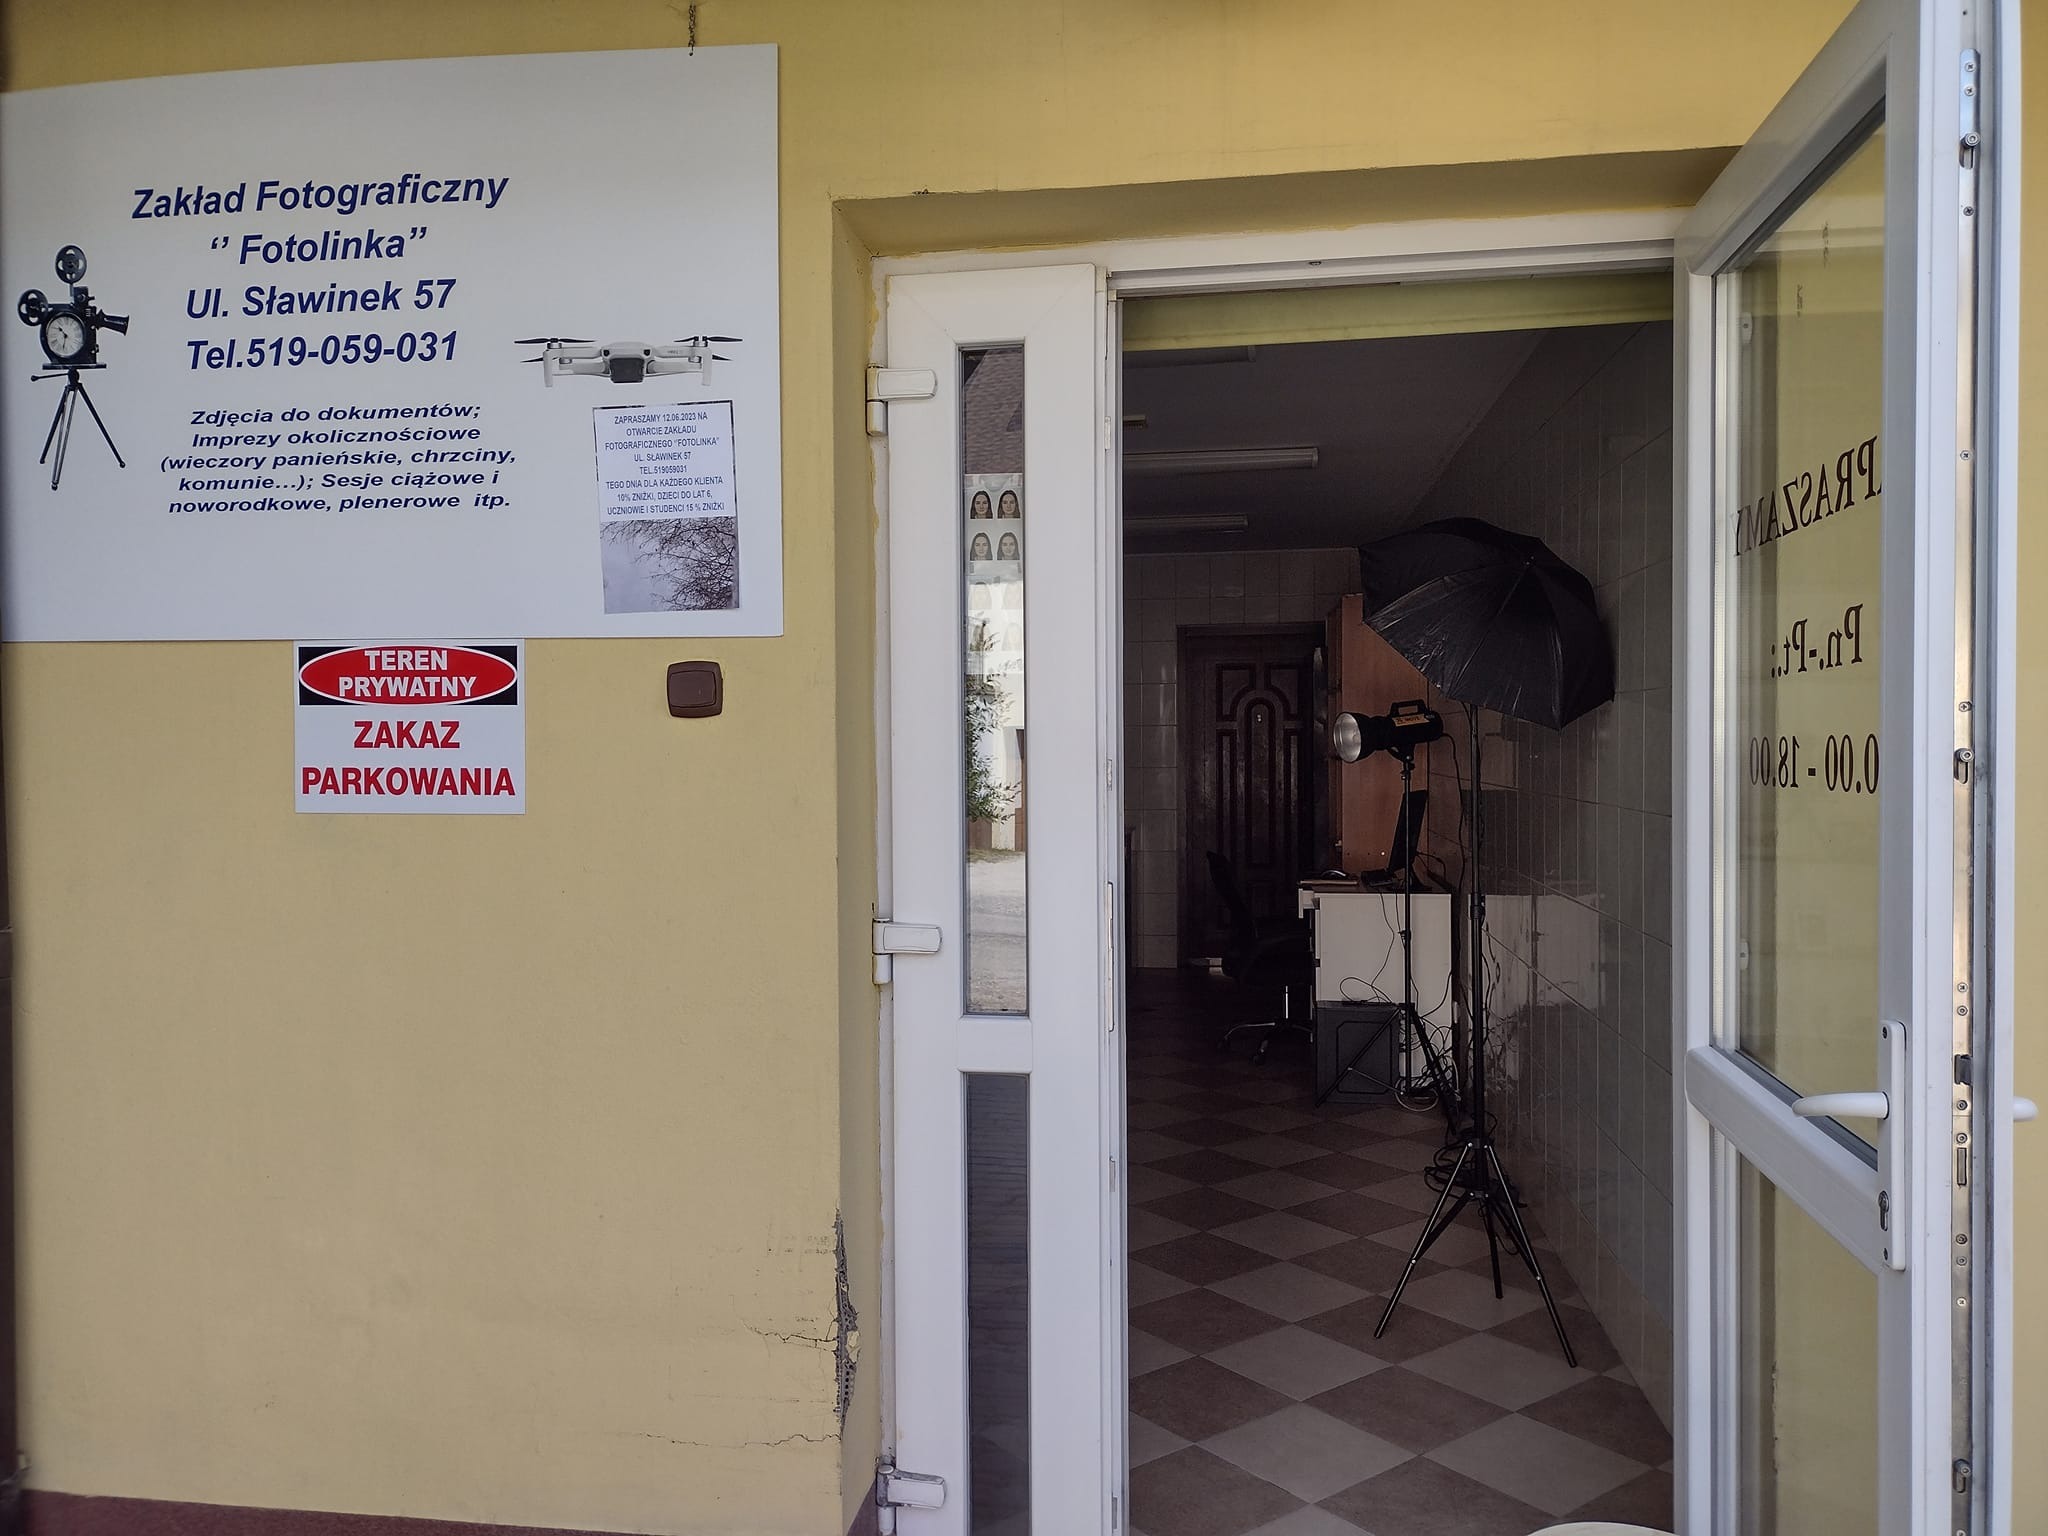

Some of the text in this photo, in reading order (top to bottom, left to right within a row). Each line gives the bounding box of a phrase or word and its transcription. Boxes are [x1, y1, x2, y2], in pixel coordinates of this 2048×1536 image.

[132, 173, 509, 219] Zakład Fotograficzny
[186, 279, 456, 318] Ul. Sławinek 57
[187, 330, 457, 369] Tel.519-059-031
[191, 403, 481, 427] Zdjęcia do dokumentów;
[614, 412, 708, 424] ZAPRASZAMY 12.06.2023 NA
[192, 428, 481, 449] Imprezy okolicznościowe
[626, 425, 697, 436] OTWARCIE ZAKŁADU
[605, 439, 672, 450] FOTOGRAFICZNEGO
[160, 448, 516, 472] (wieczory panieńskie, chrzciny,
[647, 452, 682, 461] SŁAWINEK
[684, 452, 691, 460] 57
[640, 465, 687, 474] TEL.519059031
[179, 470, 499, 491] komunie...); Sesje ciążowe i
[606, 476, 723, 489] TEGO DNIA DLA KAŻDEGO KLIENTA
[169, 493, 510, 513] noworodkowe, plenerowe itp.
[658, 491, 679, 500] DZIECI
[681, 490, 691, 498] DO
[693, 490, 706, 498] LAT
[706, 490, 712, 498] 6,
[607, 506, 645, 515] UCZNIOWIE
[650, 504, 685, 513] STUDENCI
[364, 650, 448, 671] TEREN
[338, 676, 477, 697] PRYWATNY
[353, 720, 461, 749] ZAKAZ
[301, 767, 517, 796] PARKOWANIA
